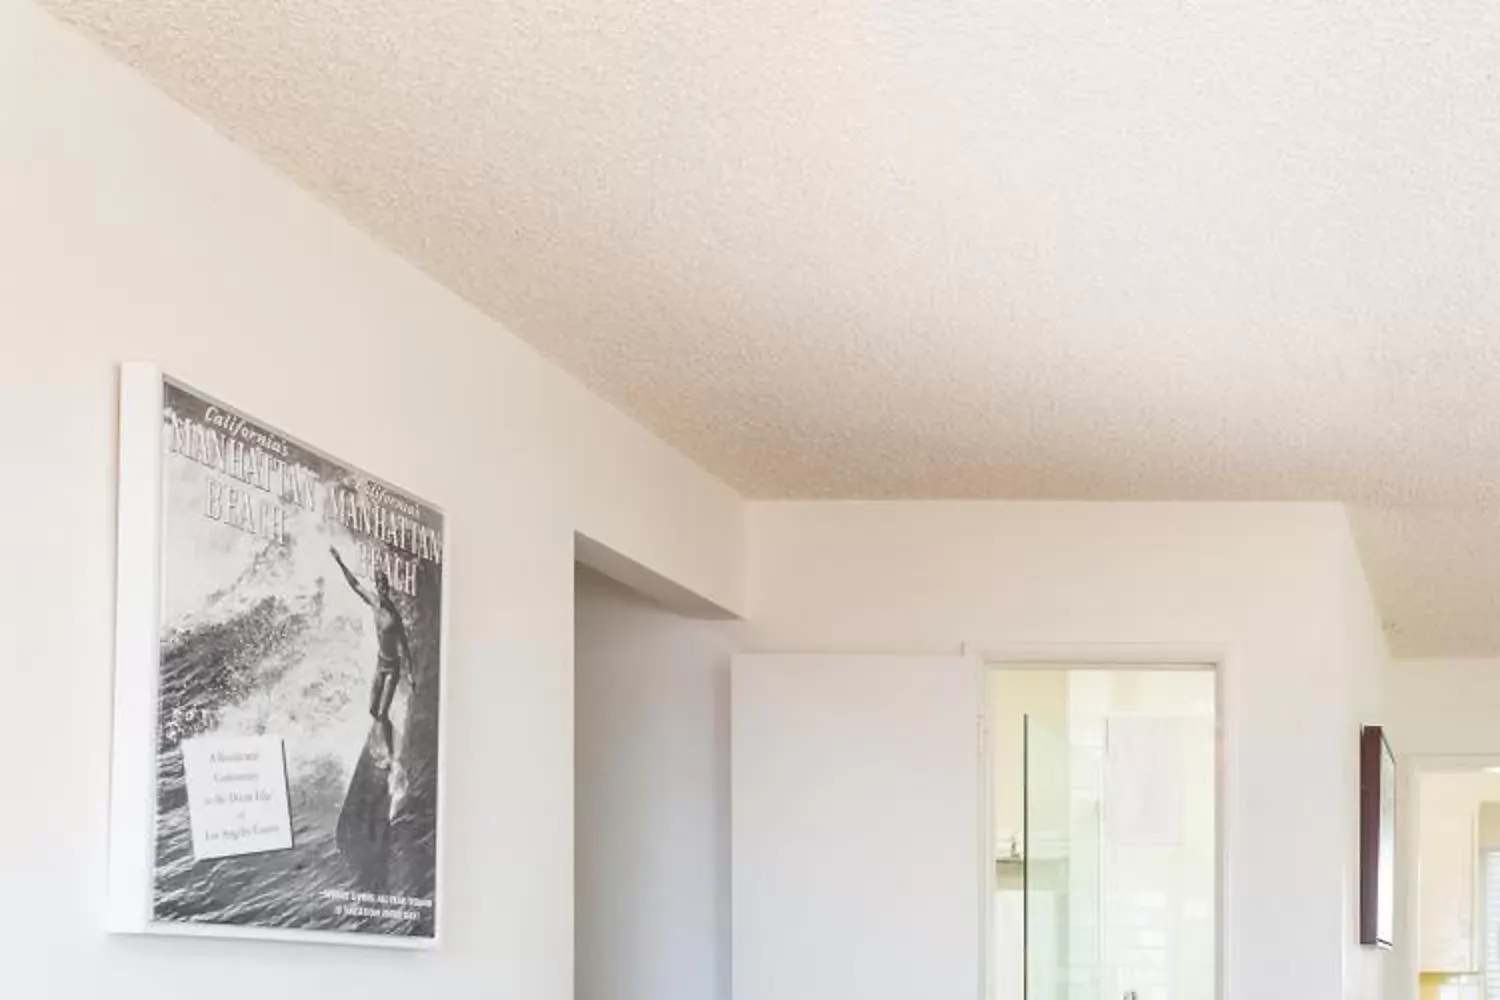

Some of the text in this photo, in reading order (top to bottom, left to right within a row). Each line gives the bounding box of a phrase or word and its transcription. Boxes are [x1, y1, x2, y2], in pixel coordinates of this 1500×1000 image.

[205, 404, 289, 457] California's
[205, 476, 287, 546] BEACH
[326, 486, 441, 565] MANHATTAN
[360, 539, 419, 597] BEACH
